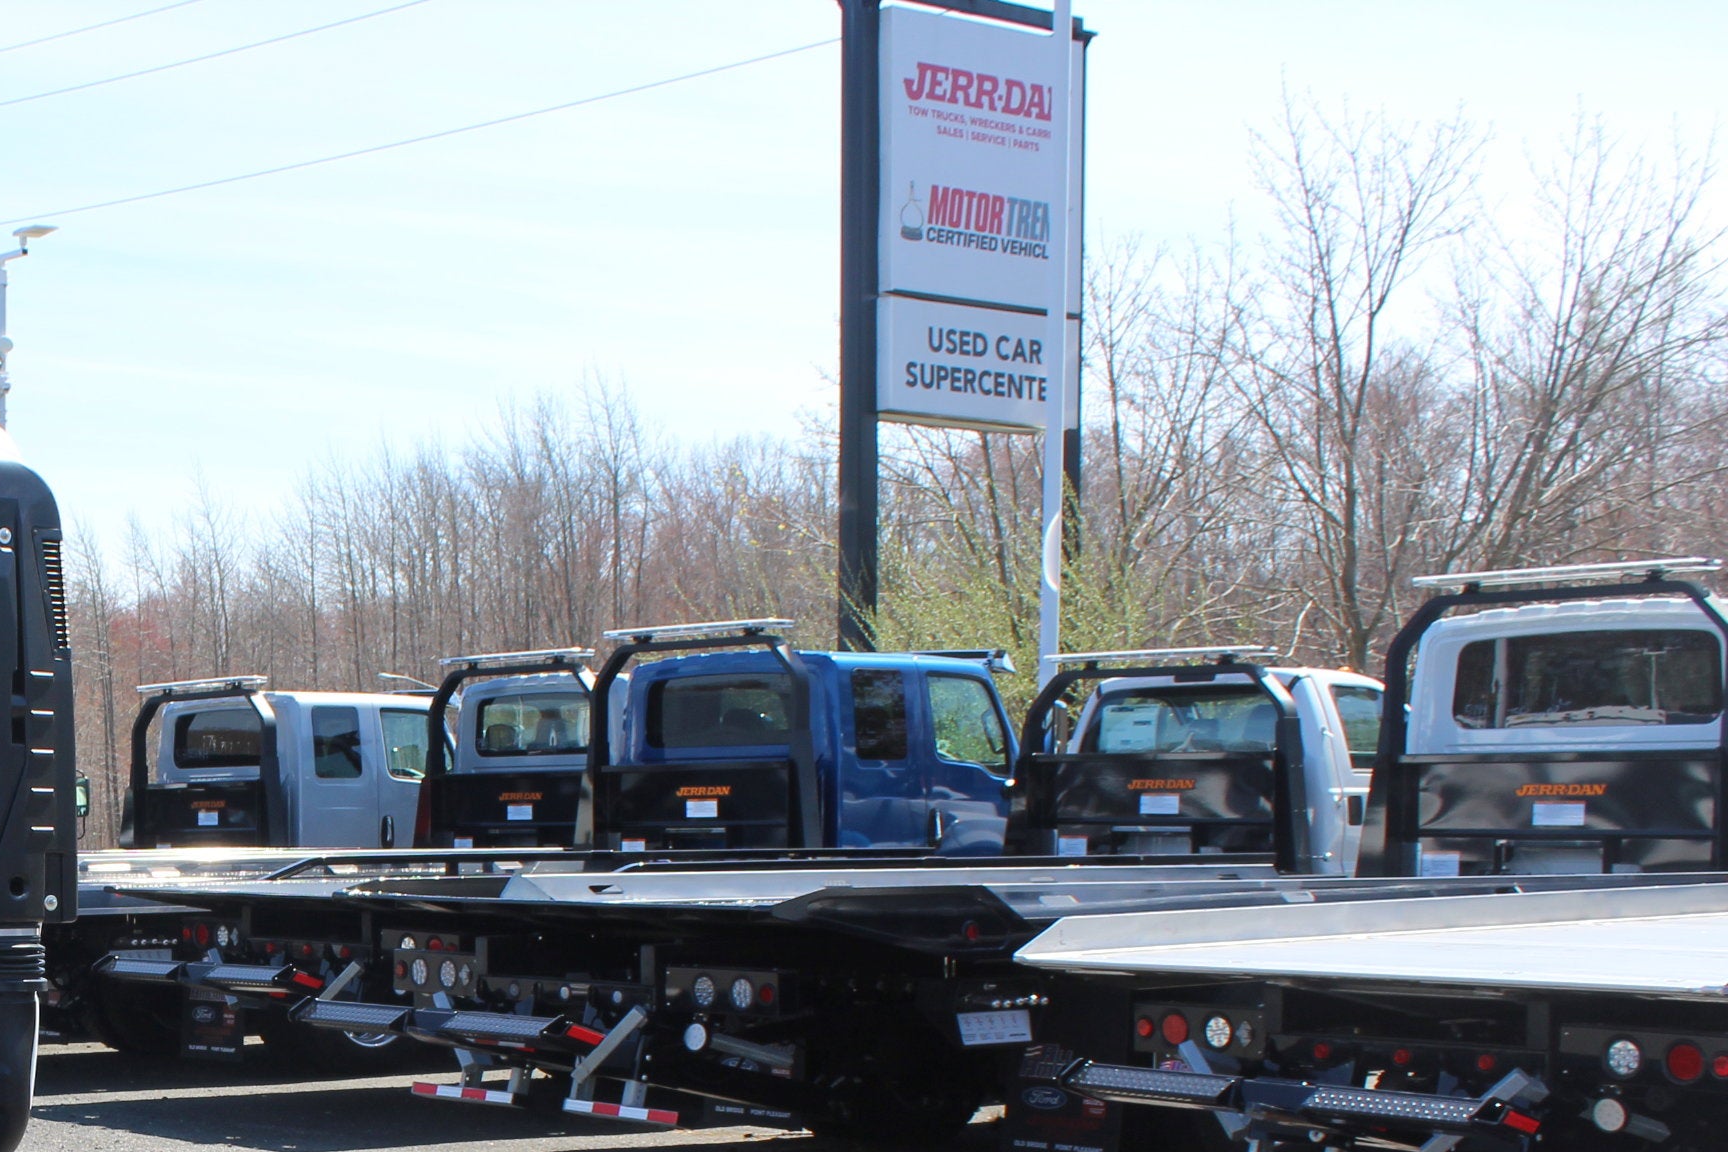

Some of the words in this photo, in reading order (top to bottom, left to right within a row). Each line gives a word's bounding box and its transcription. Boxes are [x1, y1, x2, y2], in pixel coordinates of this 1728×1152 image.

[907, 105, 929, 118] TOW
[931, 109, 967, 126] TRUCKS,
[970, 116, 1016, 134] WRECKERS
[1025, 126, 1052, 139] CARRI
[936, 125, 964, 139] SALES
[970, 131, 1007, 146] SERVICE
[1012, 138, 1040, 152] PARTS
[926, 227, 998, 252] CERTIFIED
[1000, 238, 1050, 260] VEHICL
[928, 326, 988, 357] USED
[995, 335, 1042, 365] CAR
[905, 361, 1047, 402] SUPERCENTE
[1028, 1089, 1062, 1105] Ford
